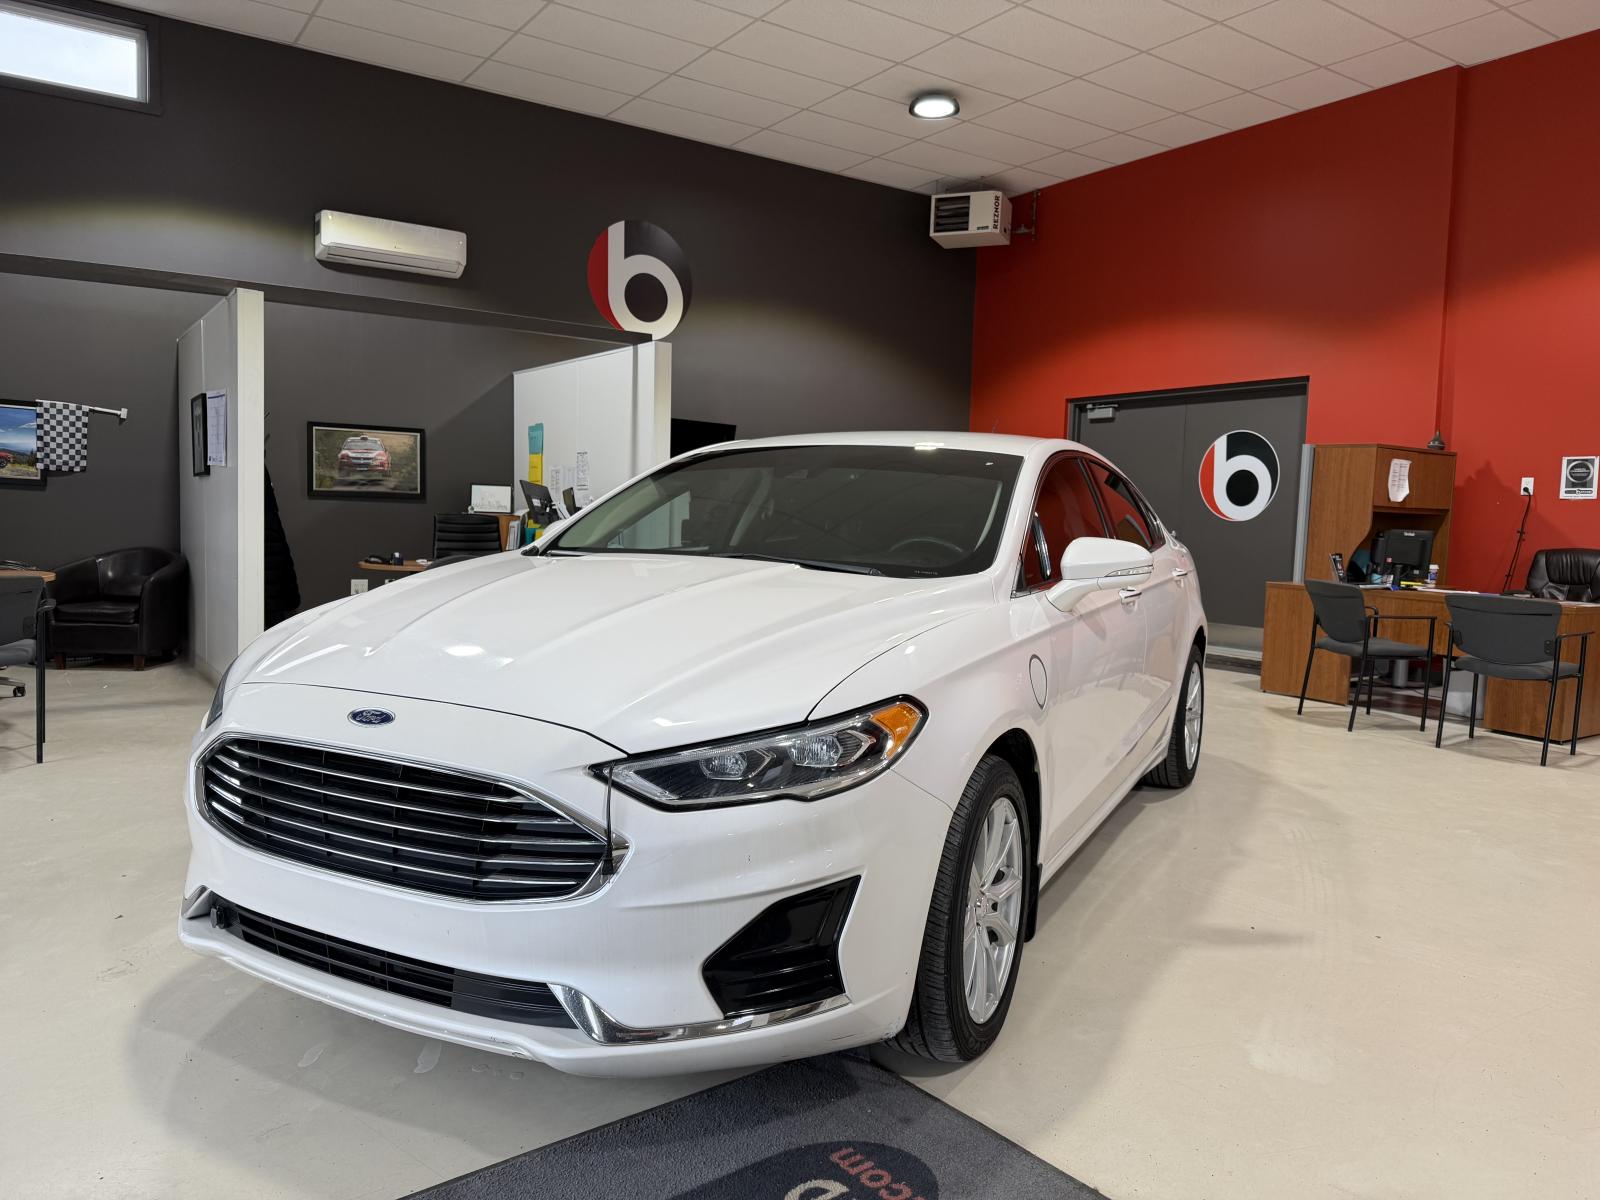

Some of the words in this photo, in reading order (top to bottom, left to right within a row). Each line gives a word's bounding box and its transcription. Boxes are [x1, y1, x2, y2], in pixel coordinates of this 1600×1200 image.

[992, 195, 1001, 230] REZNOR
[1213, 433, 1272, 522] b
[355, 710, 386, 724] Ford
